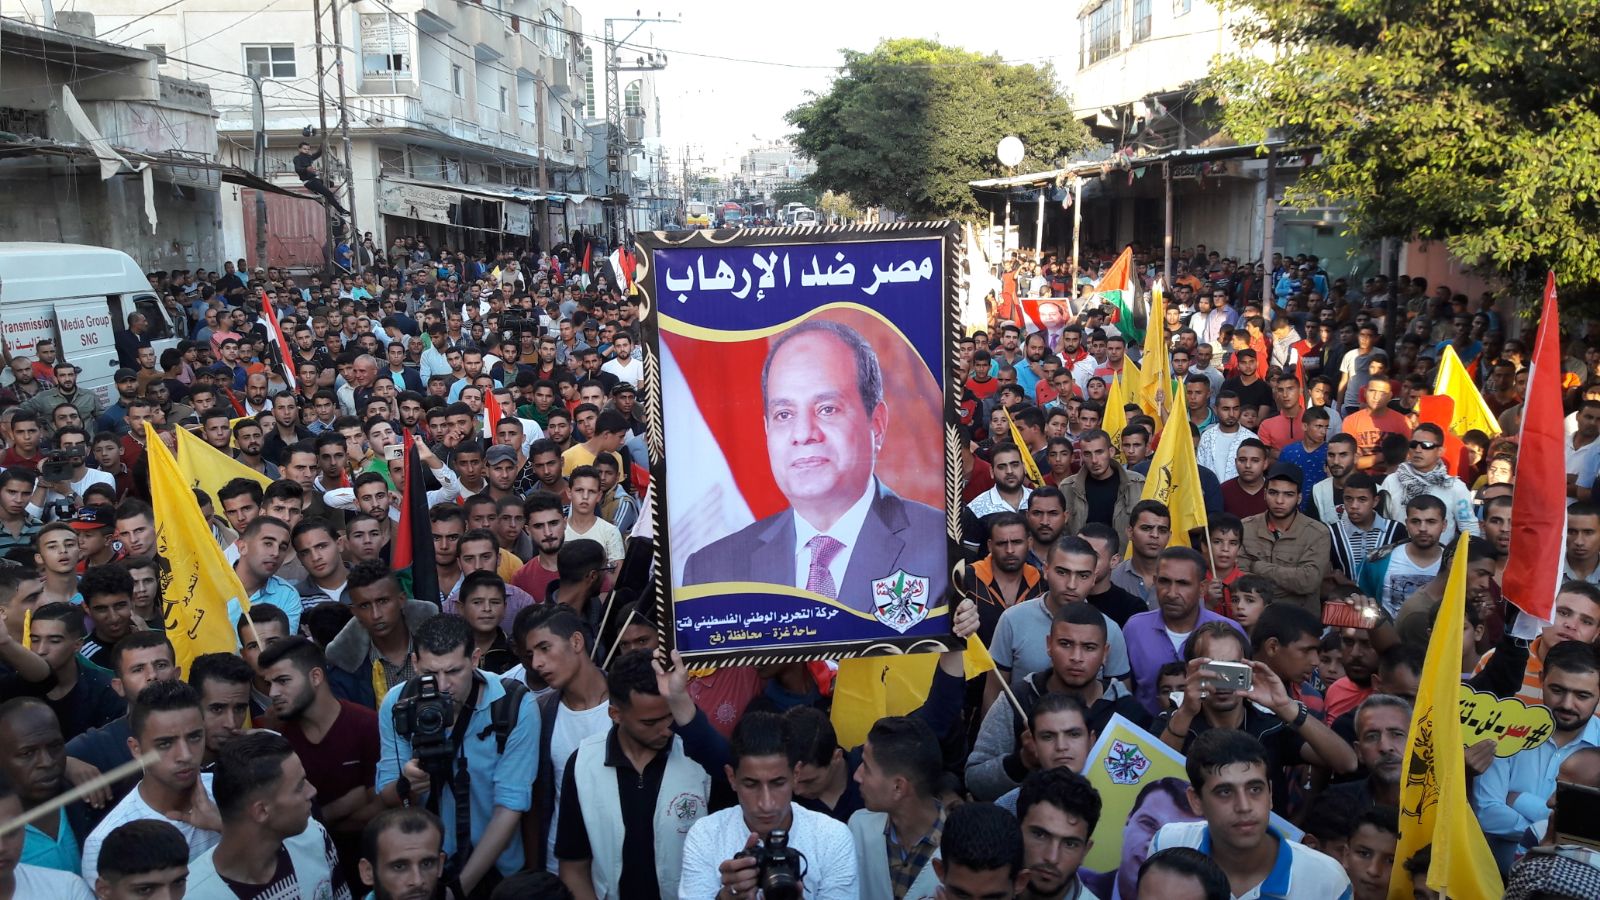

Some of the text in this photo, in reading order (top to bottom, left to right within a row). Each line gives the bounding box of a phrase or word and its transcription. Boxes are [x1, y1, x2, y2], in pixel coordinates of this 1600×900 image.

[665, 251, 934, 304] مصر ضد الإرهاب
[60, 315, 110, 332] Media Group
[80, 332, 99, 347] SNG
[676, 606, 840, 631] حركة التحرير الوطني الفلسطيني فتح
[727, 629, 763, 640] محافظة
[772, 626, 791, 640] غزة
[792, 625, 817, 636] ساحة
[709, 631, 726, 645] رفح
